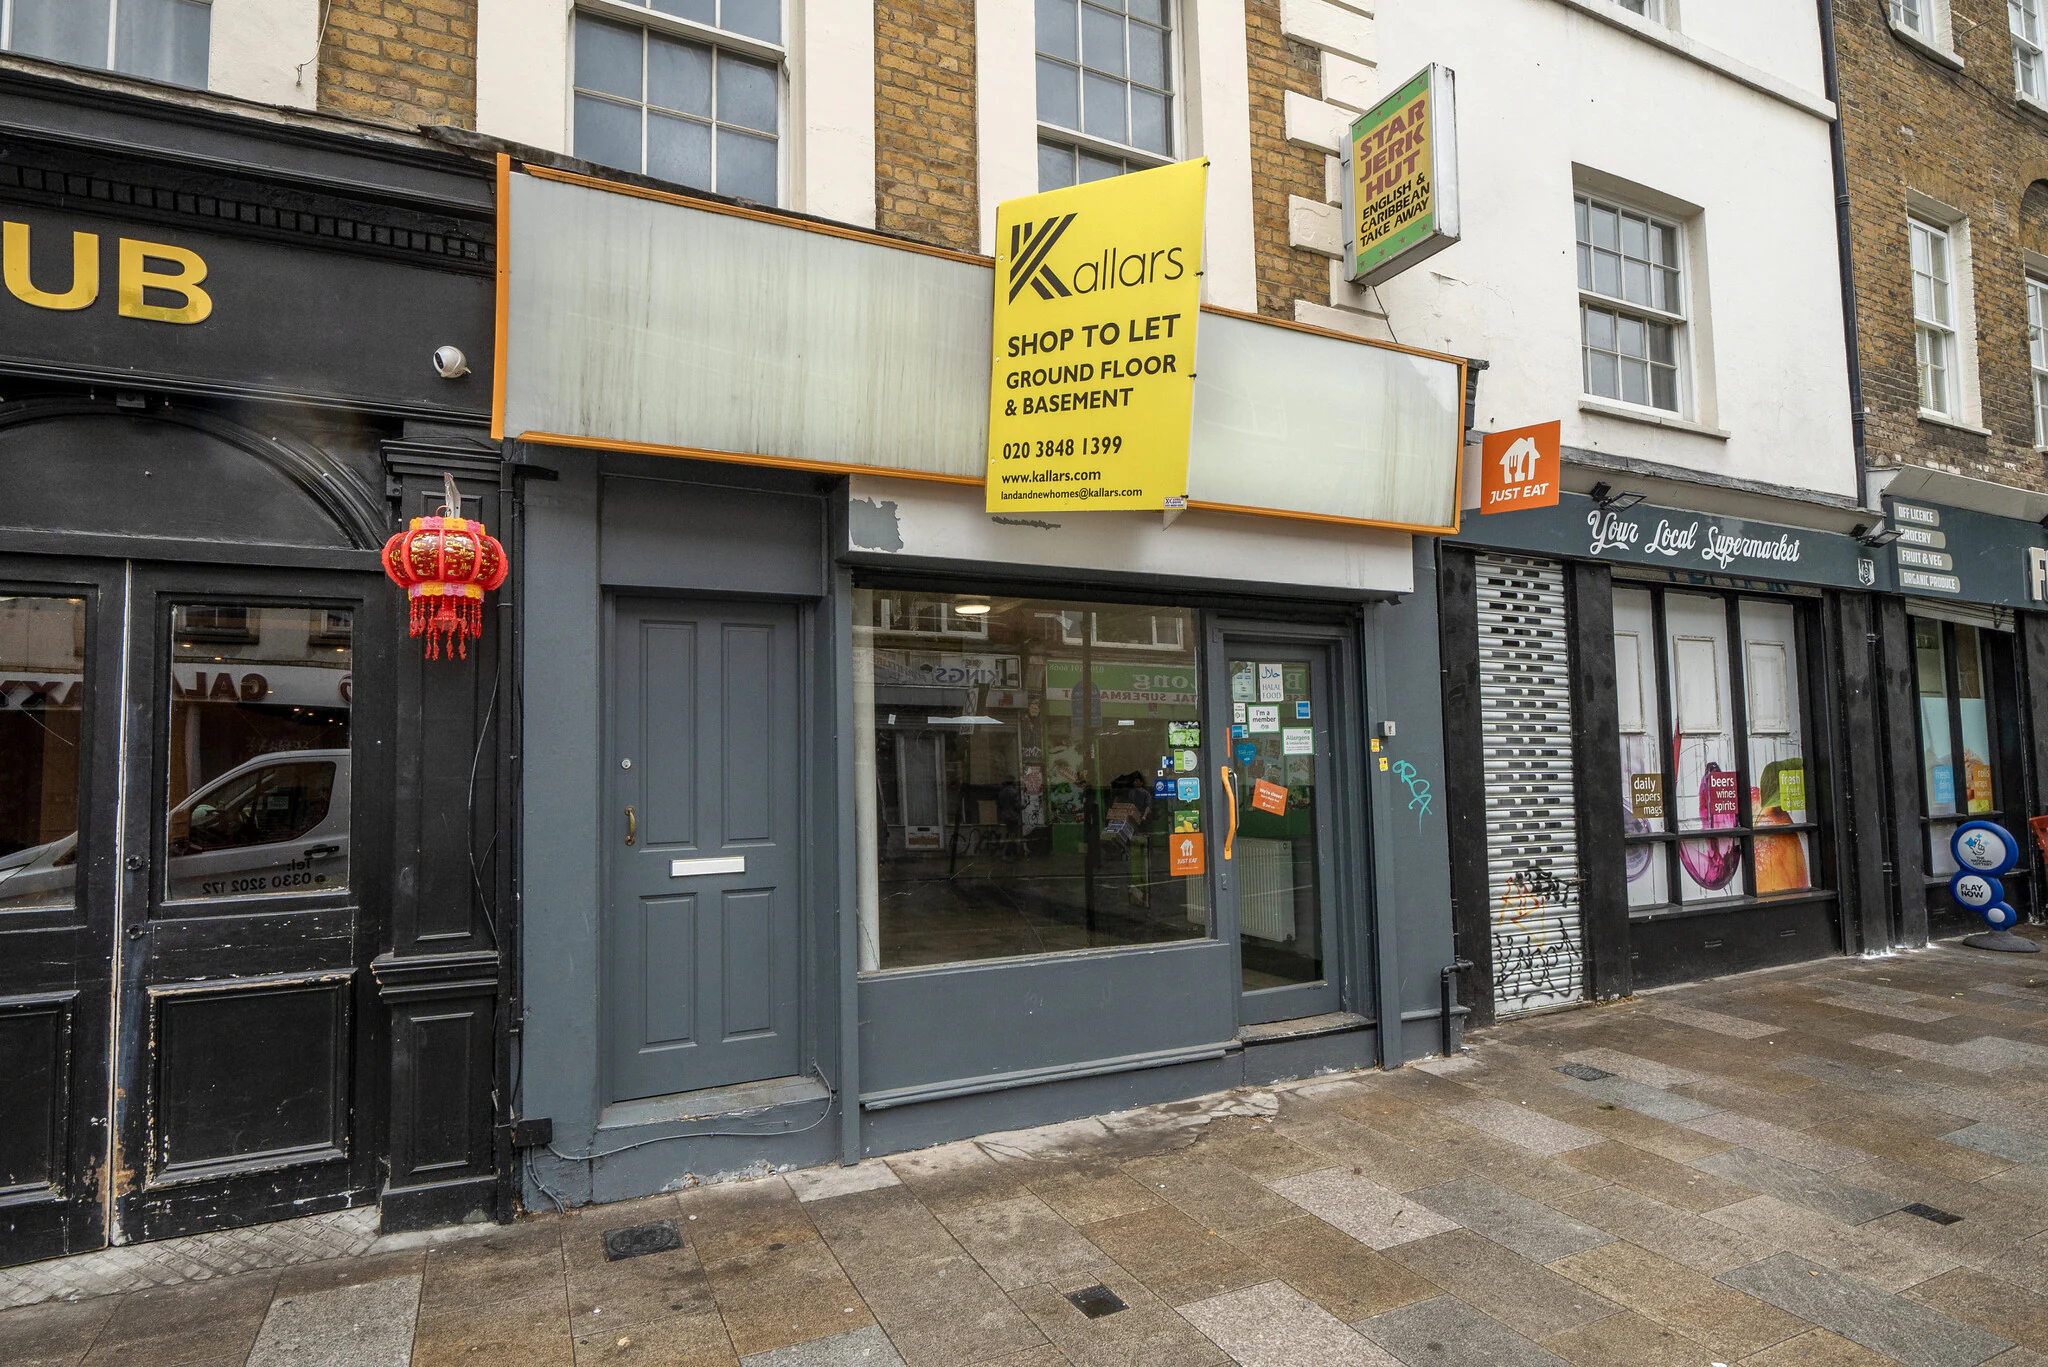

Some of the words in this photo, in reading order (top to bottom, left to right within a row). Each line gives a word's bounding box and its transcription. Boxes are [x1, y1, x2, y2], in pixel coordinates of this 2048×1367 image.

[1360, 99, 1426, 162] STAR
[1359, 121, 1425, 183] JERK
[1365, 149, 1421, 203] HUT
[1360, 181, 1430, 234] CARIBBEAN
[1362, 179, 1411, 221] ENGLISH
[1416, 172, 1425, 186] &
[1360, 220, 1390, 248] TAKE
[1394, 197, 1429, 229] AWAY
[1008, 212, 1185, 305] Kallars
[3, 220, 213, 325] UB
[1007, 328, 1074, 358] SHOP
[1082, 322, 1120, 348] TO
[1129, 313, 1181, 343] LET
[1006, 363, 1094, 390] GROUND
[1101, 354, 1177, 379] FLOOR
[1005, 399, 1017, 417] &
[1023, 387, 1134, 415] BASEMENT
[1003, 441, 1030, 460] 020
[1035, 438, 1075, 458] 3848
[1082, 435, 1122, 456] 1399
[1001, 469, 1101, 484] www.kallars.com
[1001, 488, 1143, 500] landandnewhomes@kallars.com
[1489, 487, 1519, 504] JUST
[1522, 482, 1549, 498] EAT
[1898, 506, 1909, 519] OFF
[1910, 508, 1934, 523] LICENCE
[1587, 510, 1638, 556] Your
[1644, 519, 1699, 556] Local
[1701, 526, 1800, 569] Supermarket
[1902, 550, 1921, 564] FRUIT
[1922, 553, 1929, 565] &
[1929, 554, 1943, 566] VEG
[2029, 547, 2048, 602] F
[1634, 777, 1656, 792] daily
[1711, 775, 1735, 788] beers
[1782, 773, 1801, 785] fresh
[1635, 793, 1661, 804] papers
[1716, 789, 1736, 798] wines
[1643, 806, 1663, 816] mags
[1715, 801, 1736, 813] spirits
[1960, 883, 1983, 891] PLAY
[1961, 890, 1984, 899] NOW
